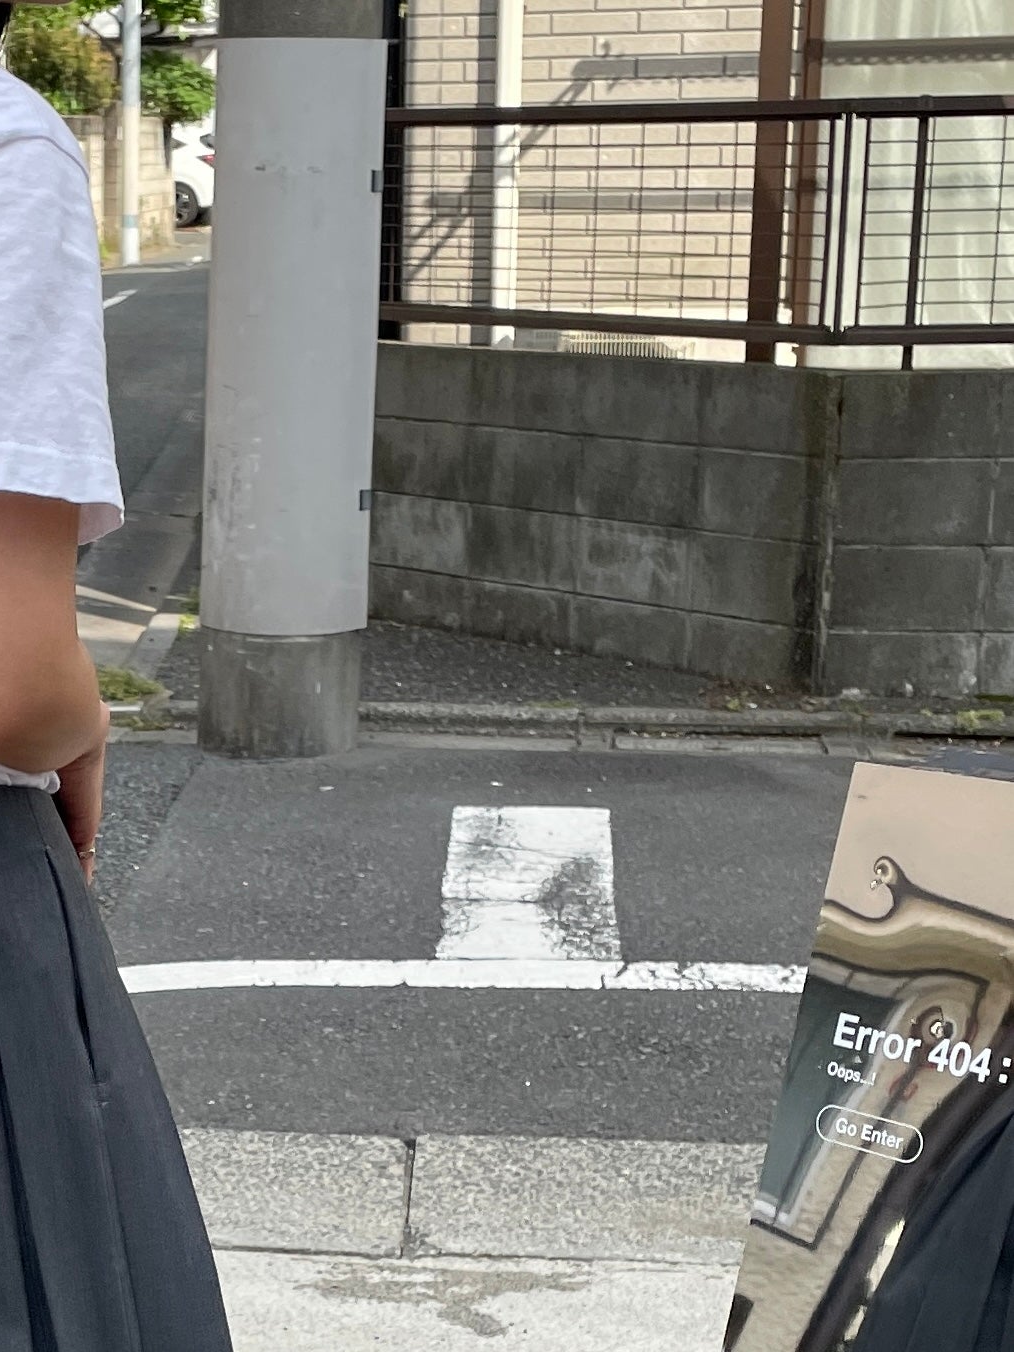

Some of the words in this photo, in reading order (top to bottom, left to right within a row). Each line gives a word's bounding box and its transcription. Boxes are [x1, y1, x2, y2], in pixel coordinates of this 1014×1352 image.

[833, 1012, 921, 1063] Error
[927, 1039, 992, 1083] 404
[836, 1117, 857, 1137] Go
[860, 1124, 904, 1150] Enter
